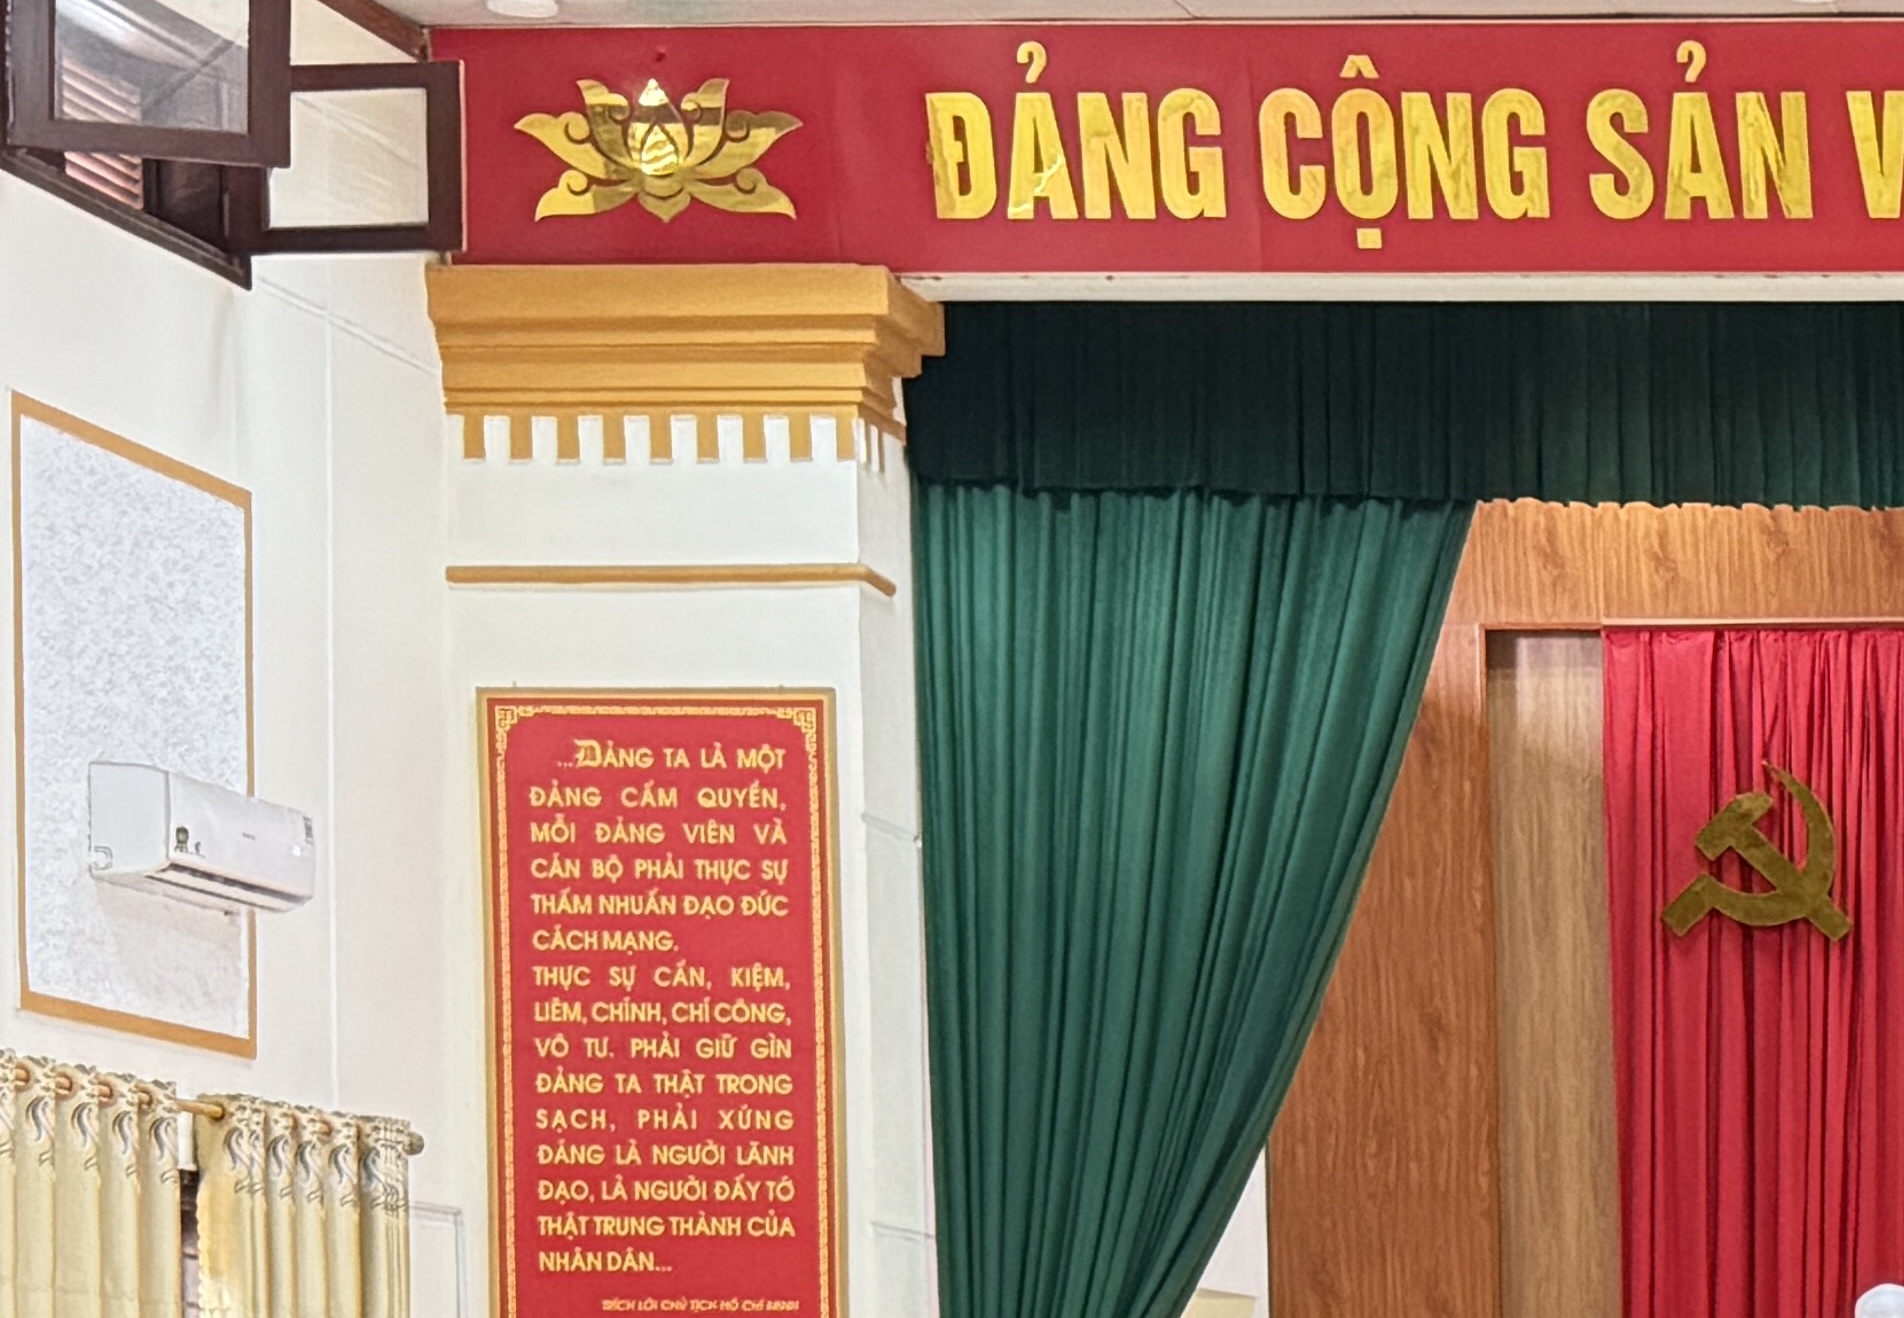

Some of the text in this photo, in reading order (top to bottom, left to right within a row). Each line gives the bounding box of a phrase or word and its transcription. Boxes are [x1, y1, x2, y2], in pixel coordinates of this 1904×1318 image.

[927, 42, 1225, 221] ĐẢNG
[1262, 56, 1544, 248] CỘNG
[1589, 40, 1809, 221] SẢN
[663, 748, 690, 768] TA
[737, 744, 785, 773] MỘT
[592, 854, 623, 883] BỘ
[635, 853, 683, 879] PHẢI
[694, 859, 750, 884] THỰC
[761, 859, 788, 885] SỰ
[536, 1066, 792, 1098] ĐẢNG TA THẬT TRONG
[538, 1211, 589, 1240] THẬT
[593, 1216, 665, 1236] TRUNG
[747, 1209, 795, 1236] CỦA
